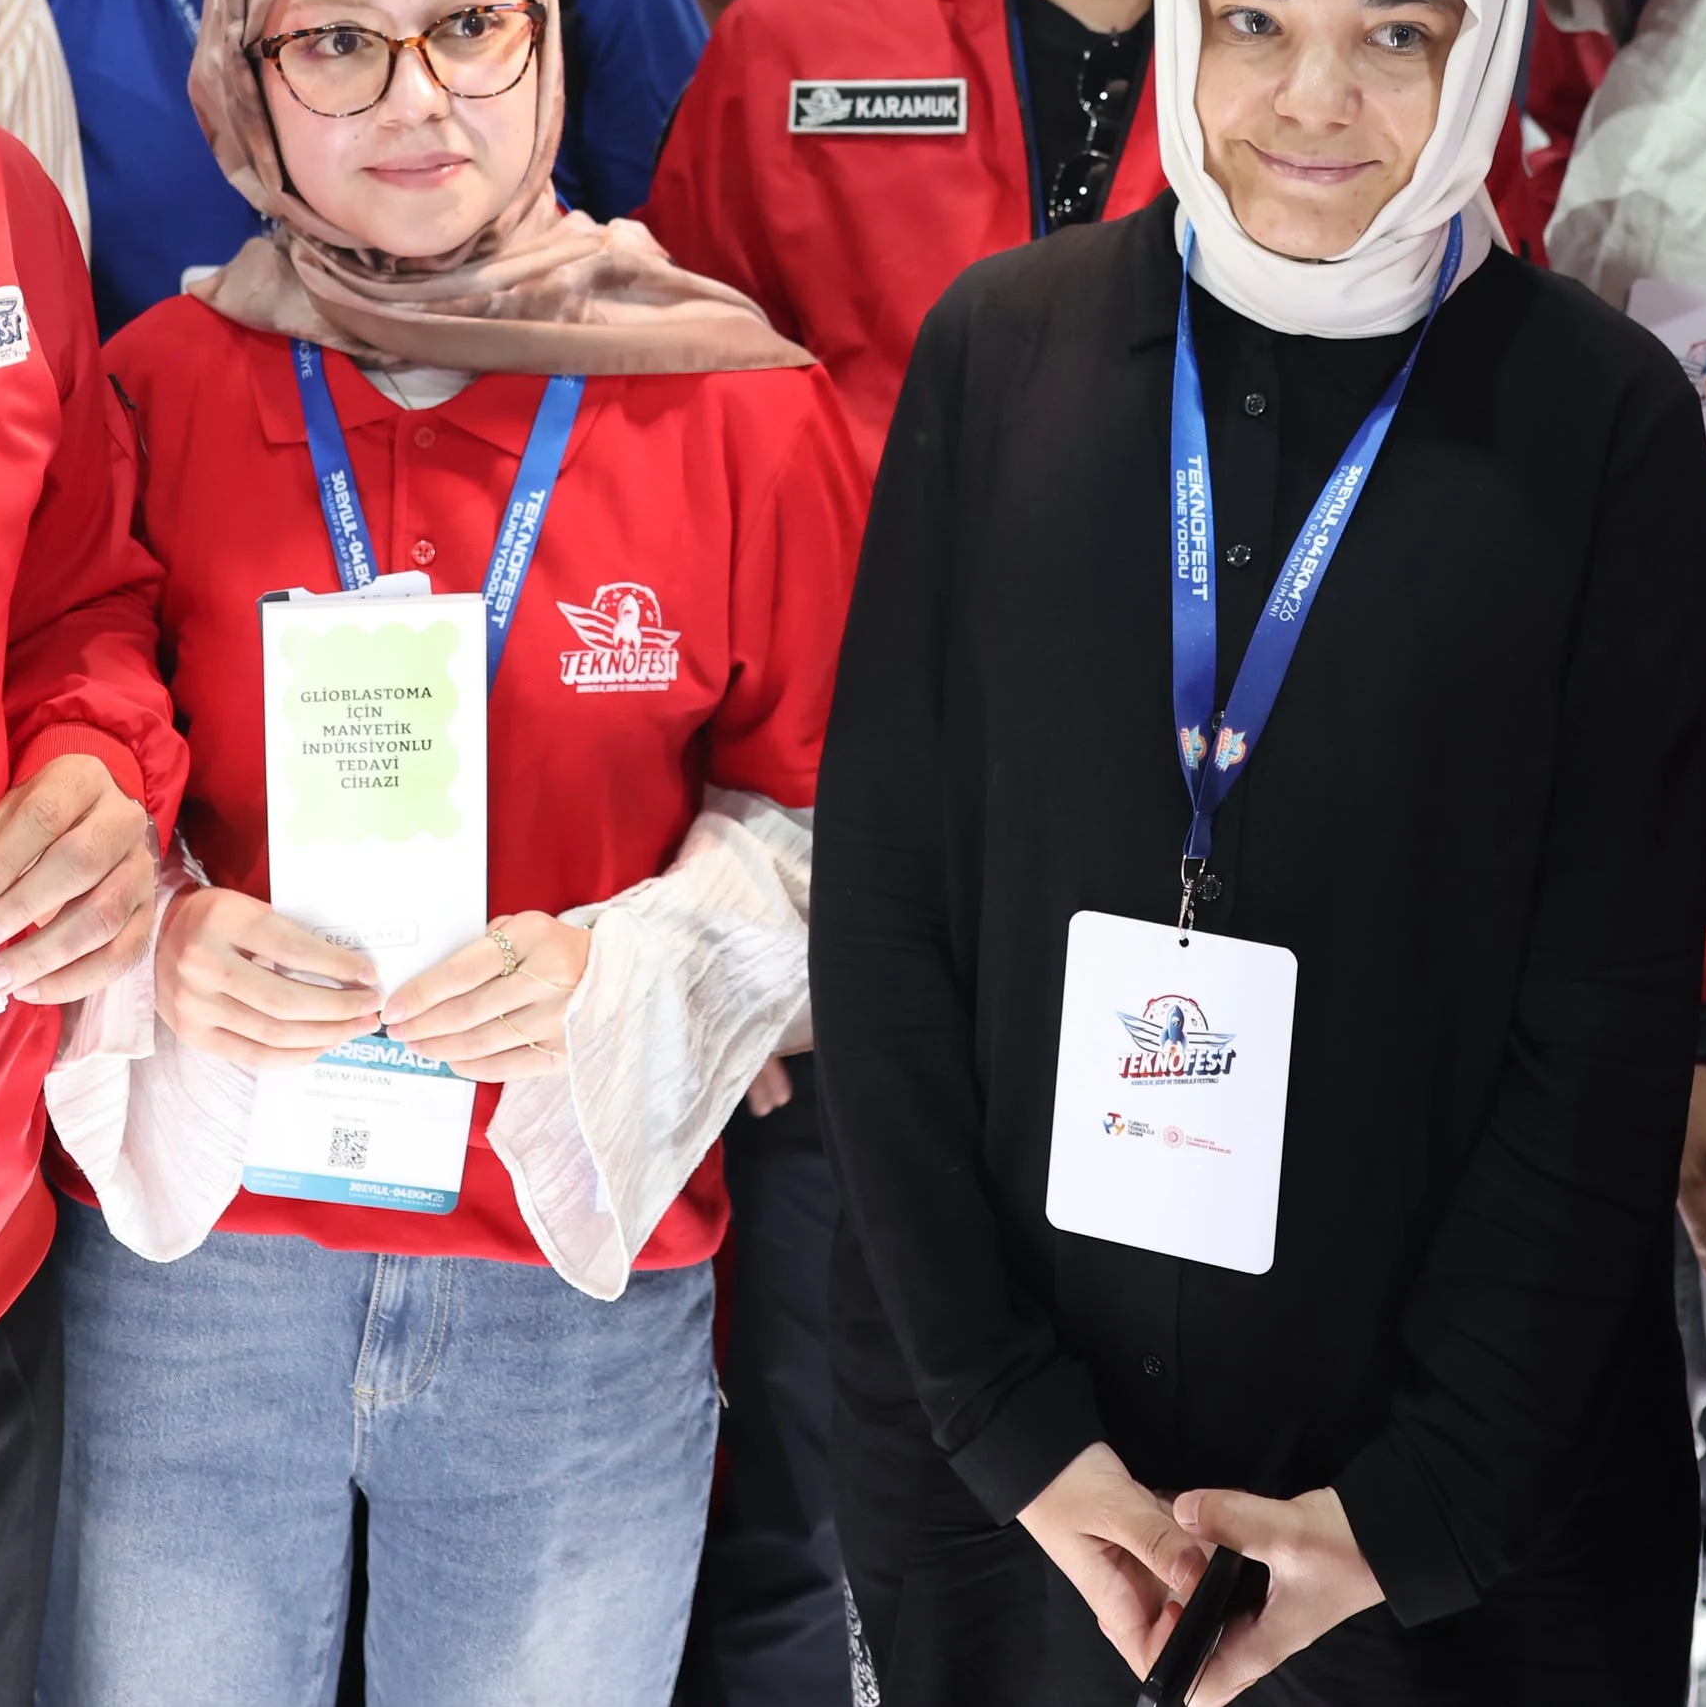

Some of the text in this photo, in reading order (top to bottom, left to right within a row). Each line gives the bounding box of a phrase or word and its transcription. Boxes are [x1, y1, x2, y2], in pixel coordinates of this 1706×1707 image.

[855, 96, 957, 118] KARAMUK
[1188, 454, 1208, 601] TEKNOFEST
[1303, 524, 1318, 546] GAP
[491, 489, 546, 629] TEKNOFEST
[560, 649, 678, 683] TEKNOFEST
[301, 687, 433, 703] GLİOBLASTOMA
[347, 703, 383, 722] İÇİN
[323, 720, 412, 737] MANYETİK
[302, 739, 433, 755] İNDÜKSİYONLU
[336, 755, 400, 772] TEDAVİ
[341, 774, 400, 790] CİHAZI
[1117, 1045, 1237, 1079] TEKNOFEST
